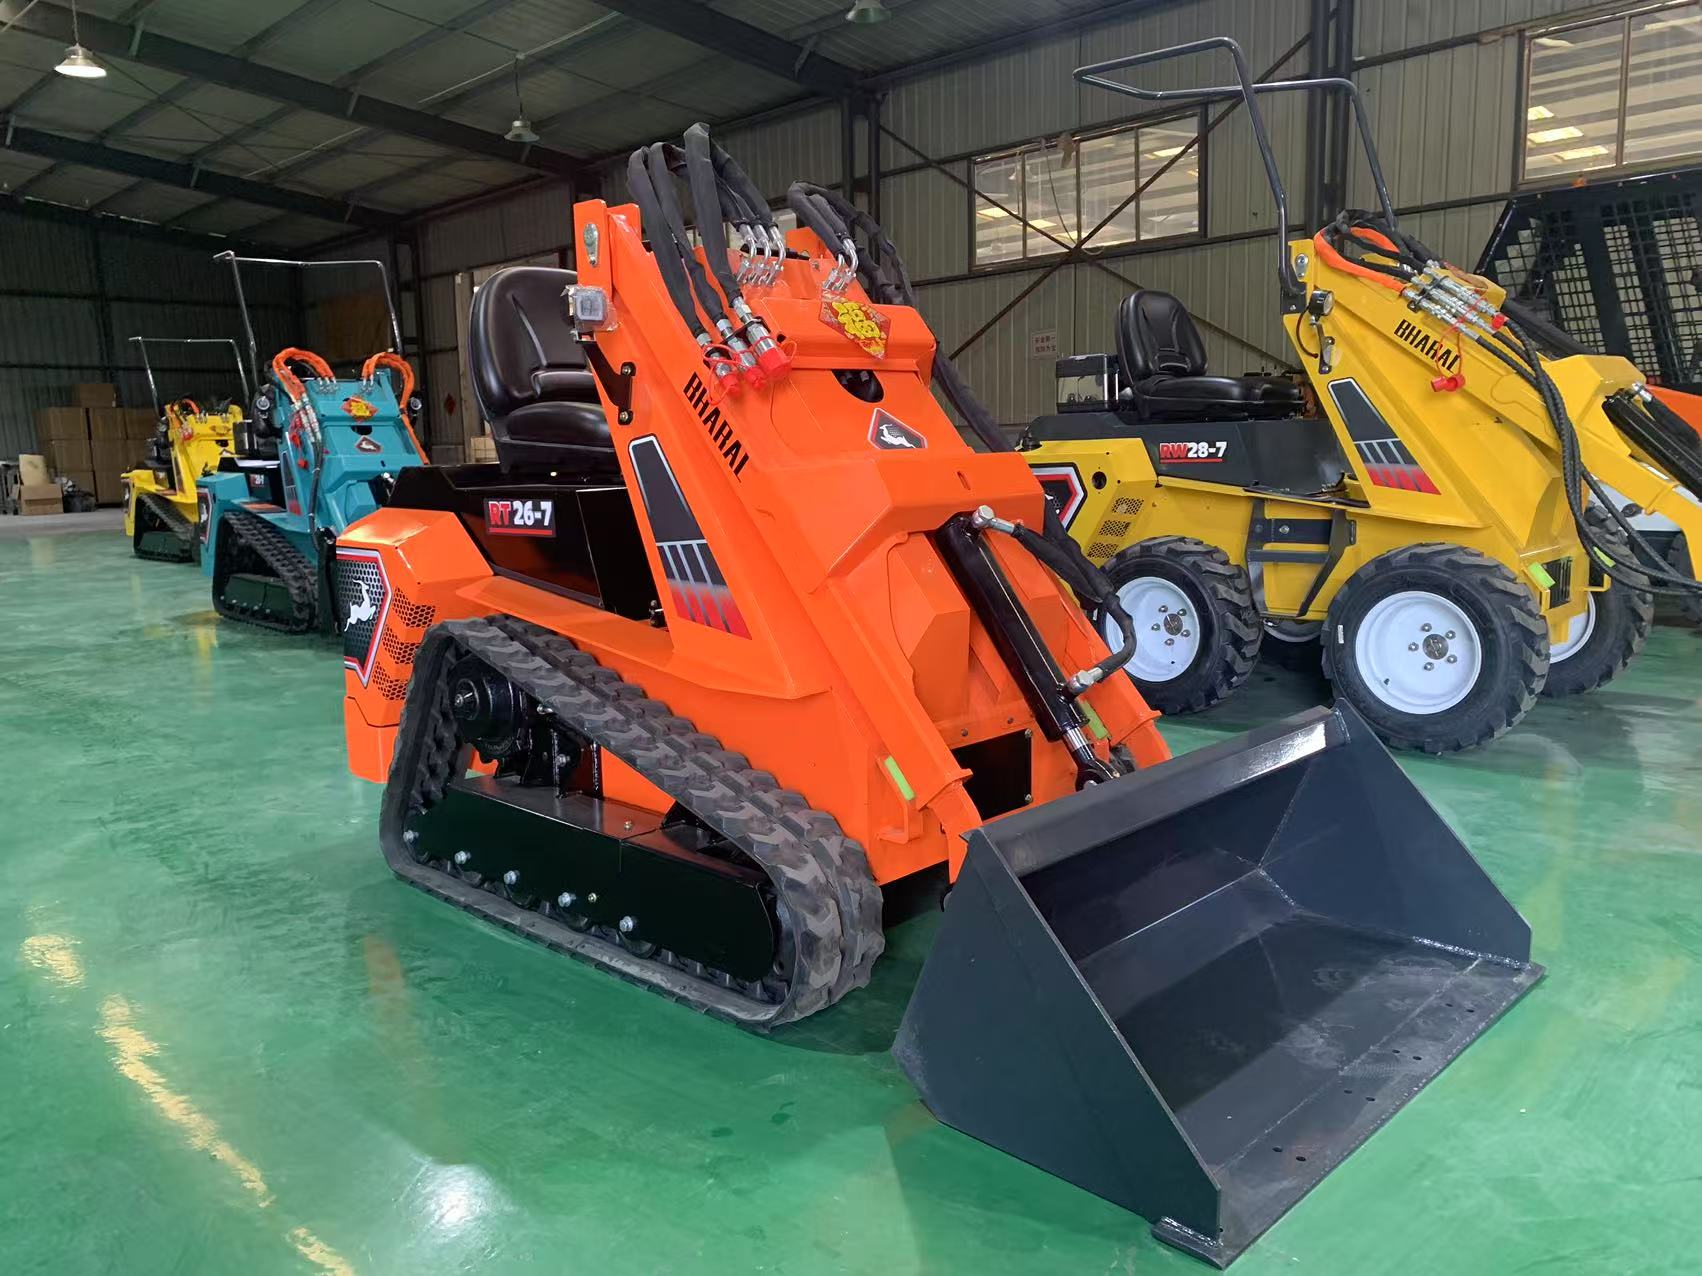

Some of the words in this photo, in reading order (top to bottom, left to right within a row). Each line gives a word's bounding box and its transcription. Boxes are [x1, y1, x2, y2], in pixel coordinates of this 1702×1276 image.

[1393, 318, 1460, 376] BHARAL
[683, 371, 750, 484] BHARAL
[1159, 441, 1228, 458] RW28-7
